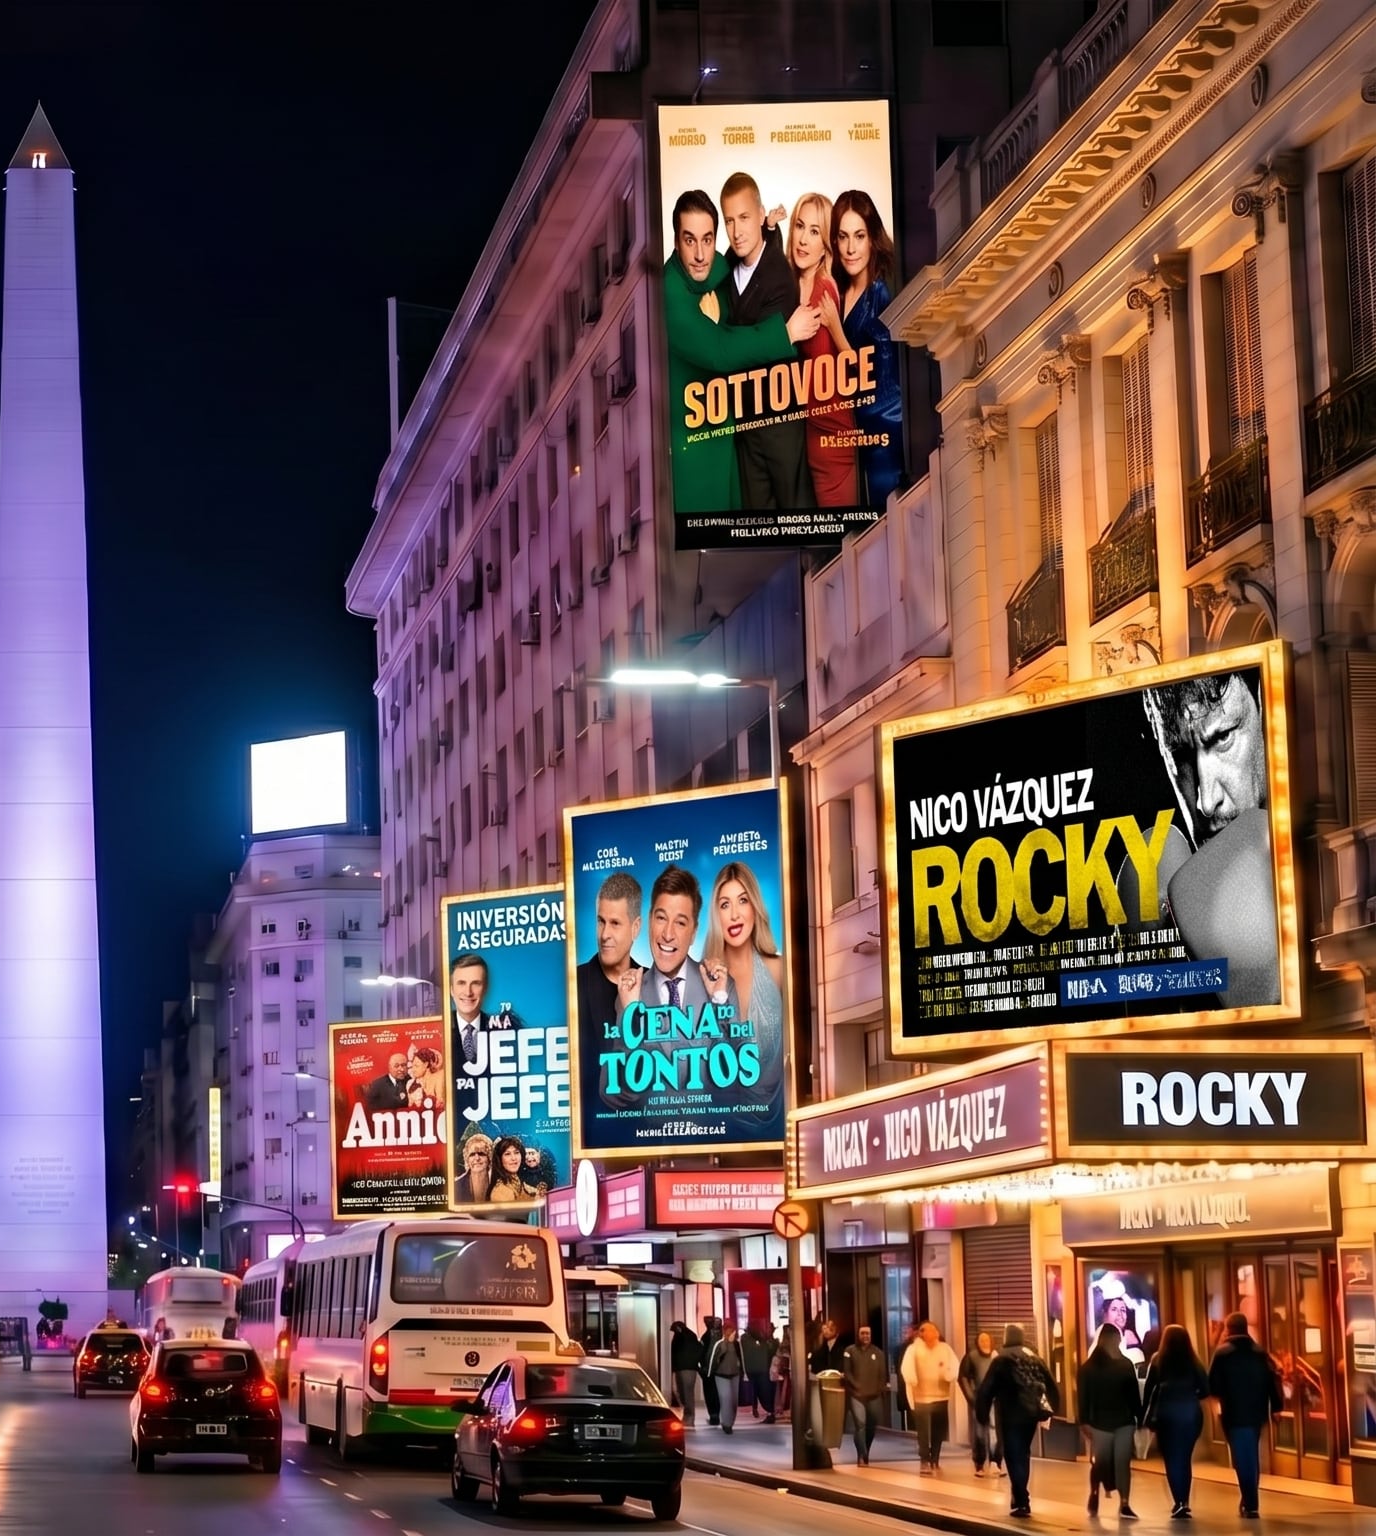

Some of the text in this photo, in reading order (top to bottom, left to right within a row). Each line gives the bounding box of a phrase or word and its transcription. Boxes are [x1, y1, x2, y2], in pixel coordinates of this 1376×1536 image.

[683, 344, 877, 429] SOTTOVOCE
[909, 768, 1095, 840] NICO VÁZQUEZ
[910, 807, 1176, 950] ROCKY
[488, 1014, 512, 1030] MA
[622, 1000, 724, 1050] CENA
[462, 1026, 569, 1077] JEFE
[598, 1042, 761, 1095] TONTOS
[455, 1077, 476, 1090] PA
[462, 1073, 571, 1122] JEFE
[1120, 1071, 1308, 1127] ROCKY
[883, 1105, 922, 1162] NICO
[925, 1084, 1008, 1153] VÁZQUEZ
